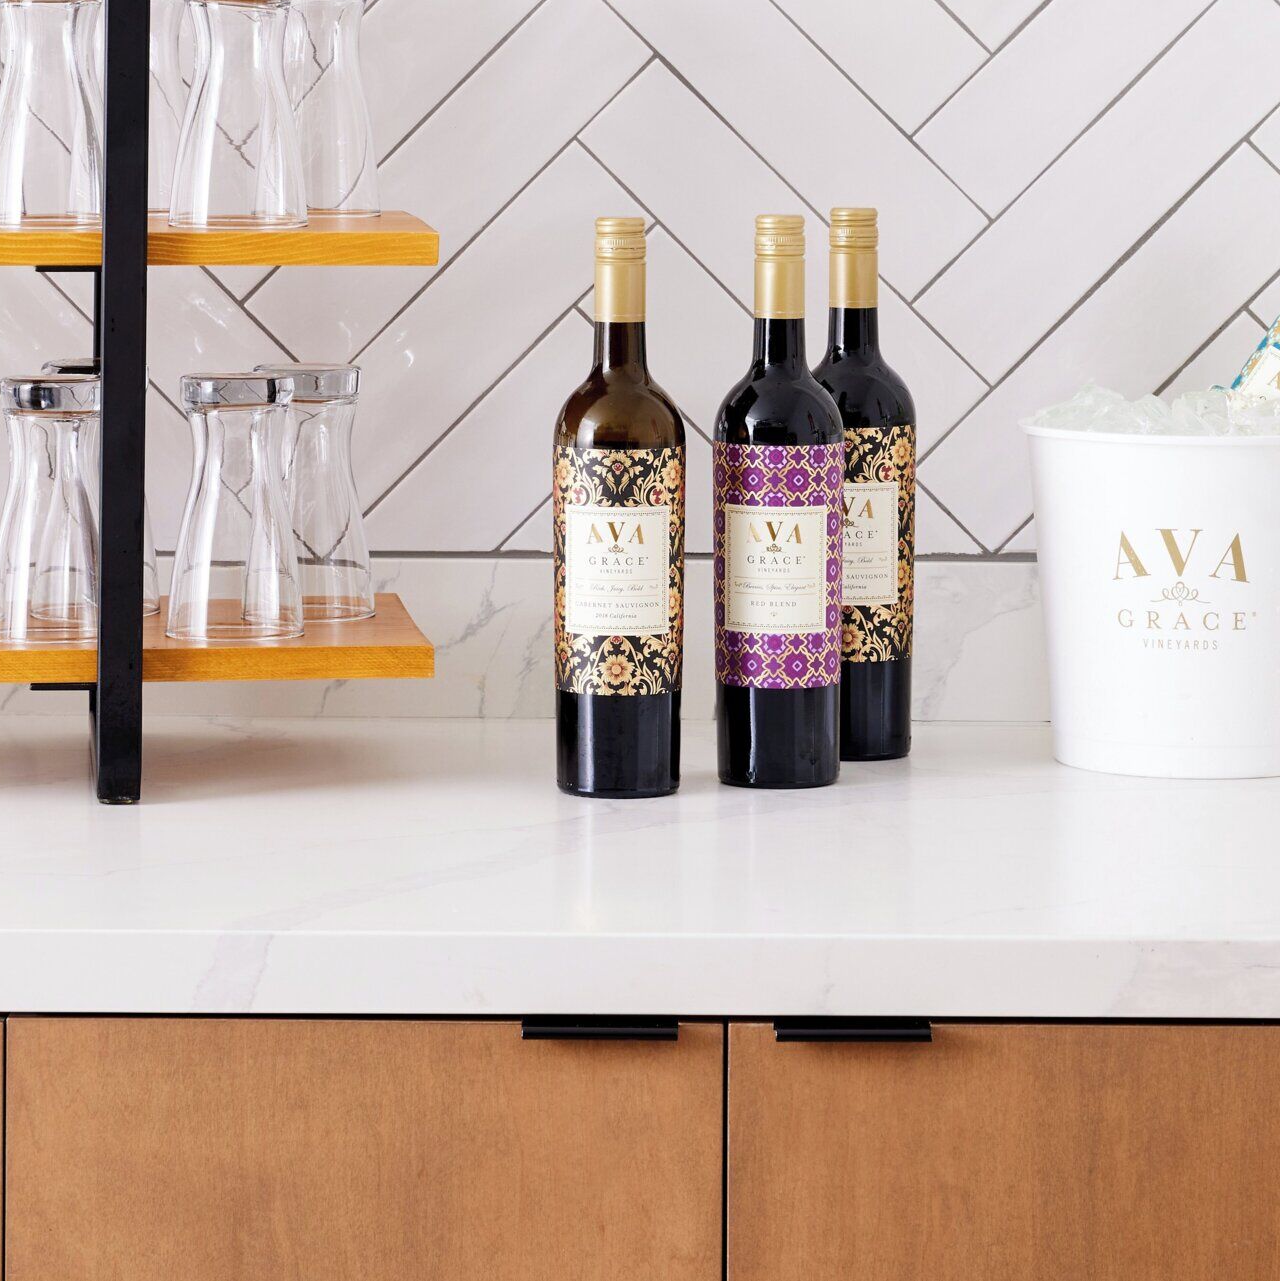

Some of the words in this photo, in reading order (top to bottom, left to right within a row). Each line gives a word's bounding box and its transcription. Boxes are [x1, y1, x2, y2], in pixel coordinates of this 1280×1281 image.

[842, 496, 874, 519] VA
[586, 521, 645, 545] AVA
[746, 520, 802, 545] AVA
[843, 531, 874, 539] ACE
[588, 556, 646, 567] GRACE
[747, 554, 803, 565] GRACE
[1112, 528, 1251, 584] AVA
[843, 583, 868, 591] alifornia
[769, 600, 798, 608] BLEND
[1117, 608, 1248, 632] GRACE
[1142, 638, 1220, 651] VINEYARDS
